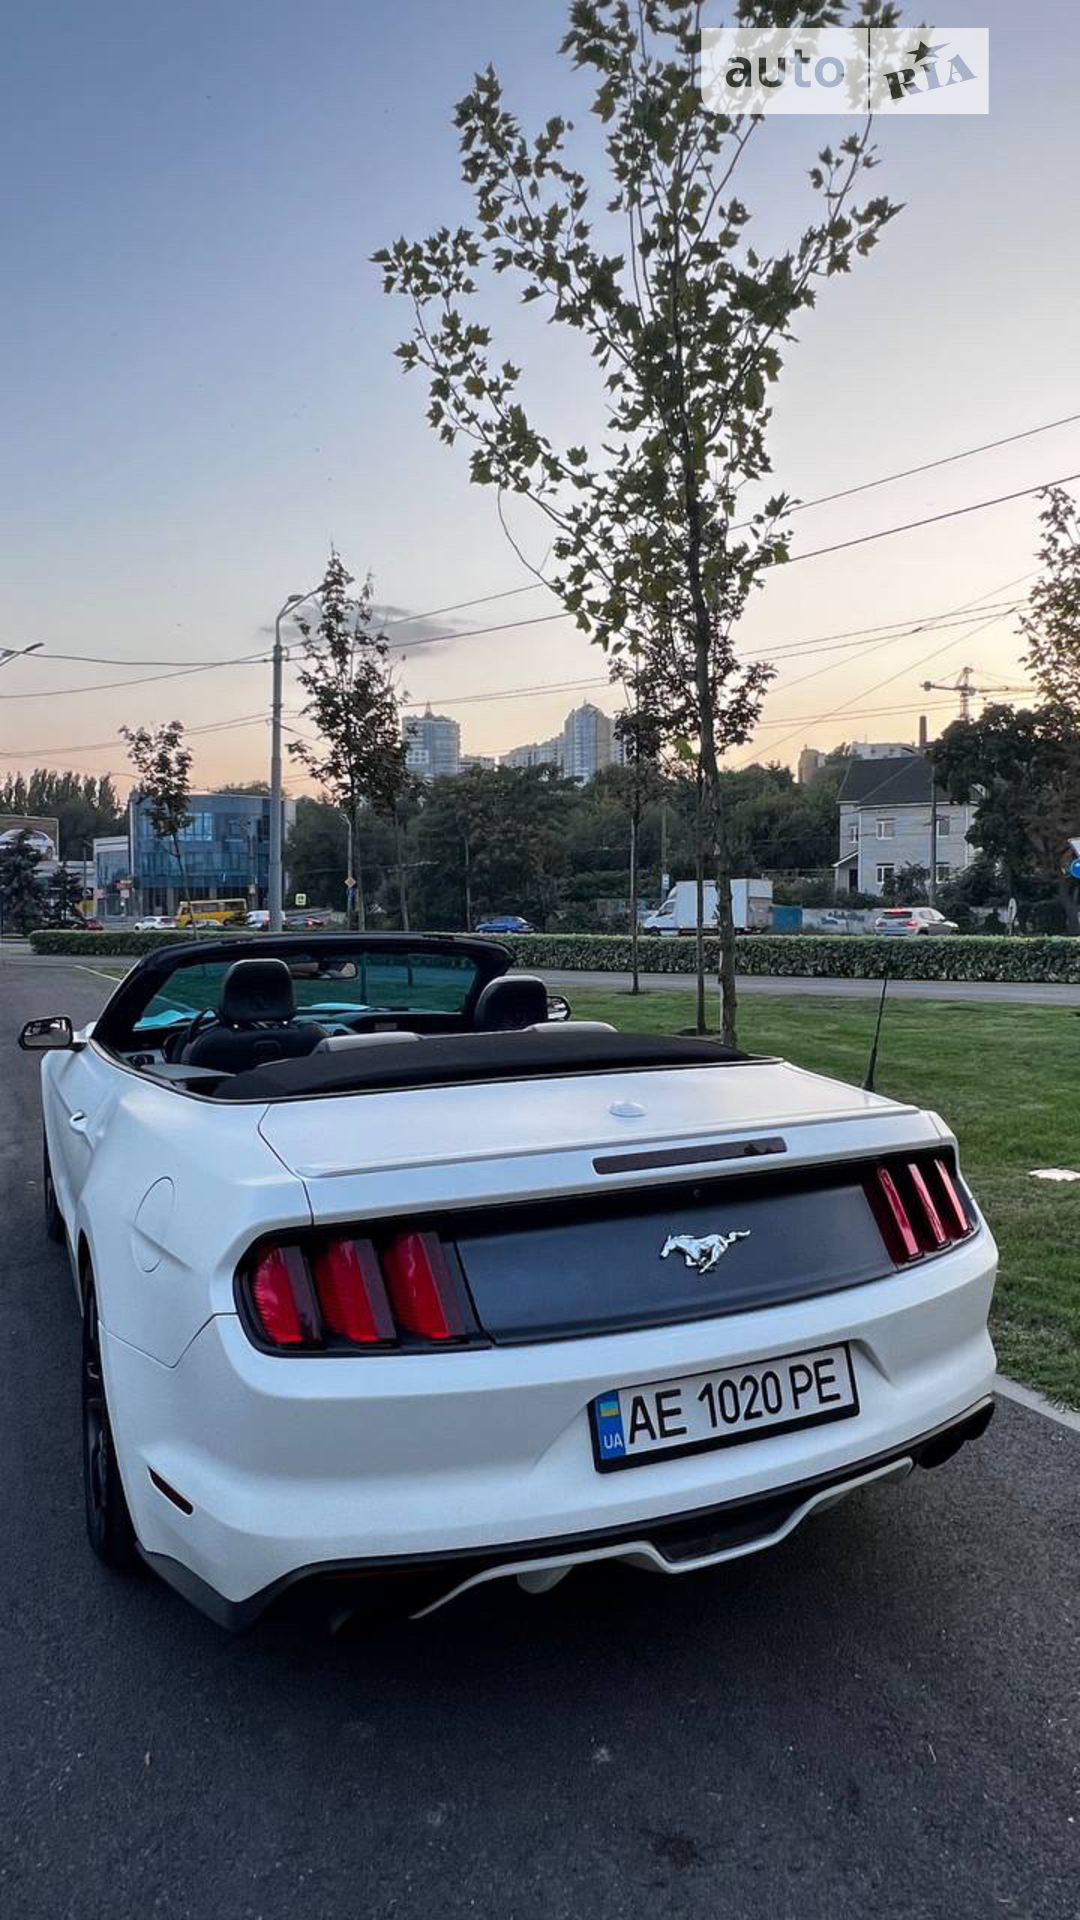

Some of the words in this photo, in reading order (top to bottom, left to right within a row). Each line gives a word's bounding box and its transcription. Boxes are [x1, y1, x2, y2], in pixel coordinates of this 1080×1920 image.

[629, 1389, 687, 1444] AE
[698, 1370, 783, 1428] 1020
[789, 1358, 841, 1410] PE
[604, 1434, 624, 1449] UA
